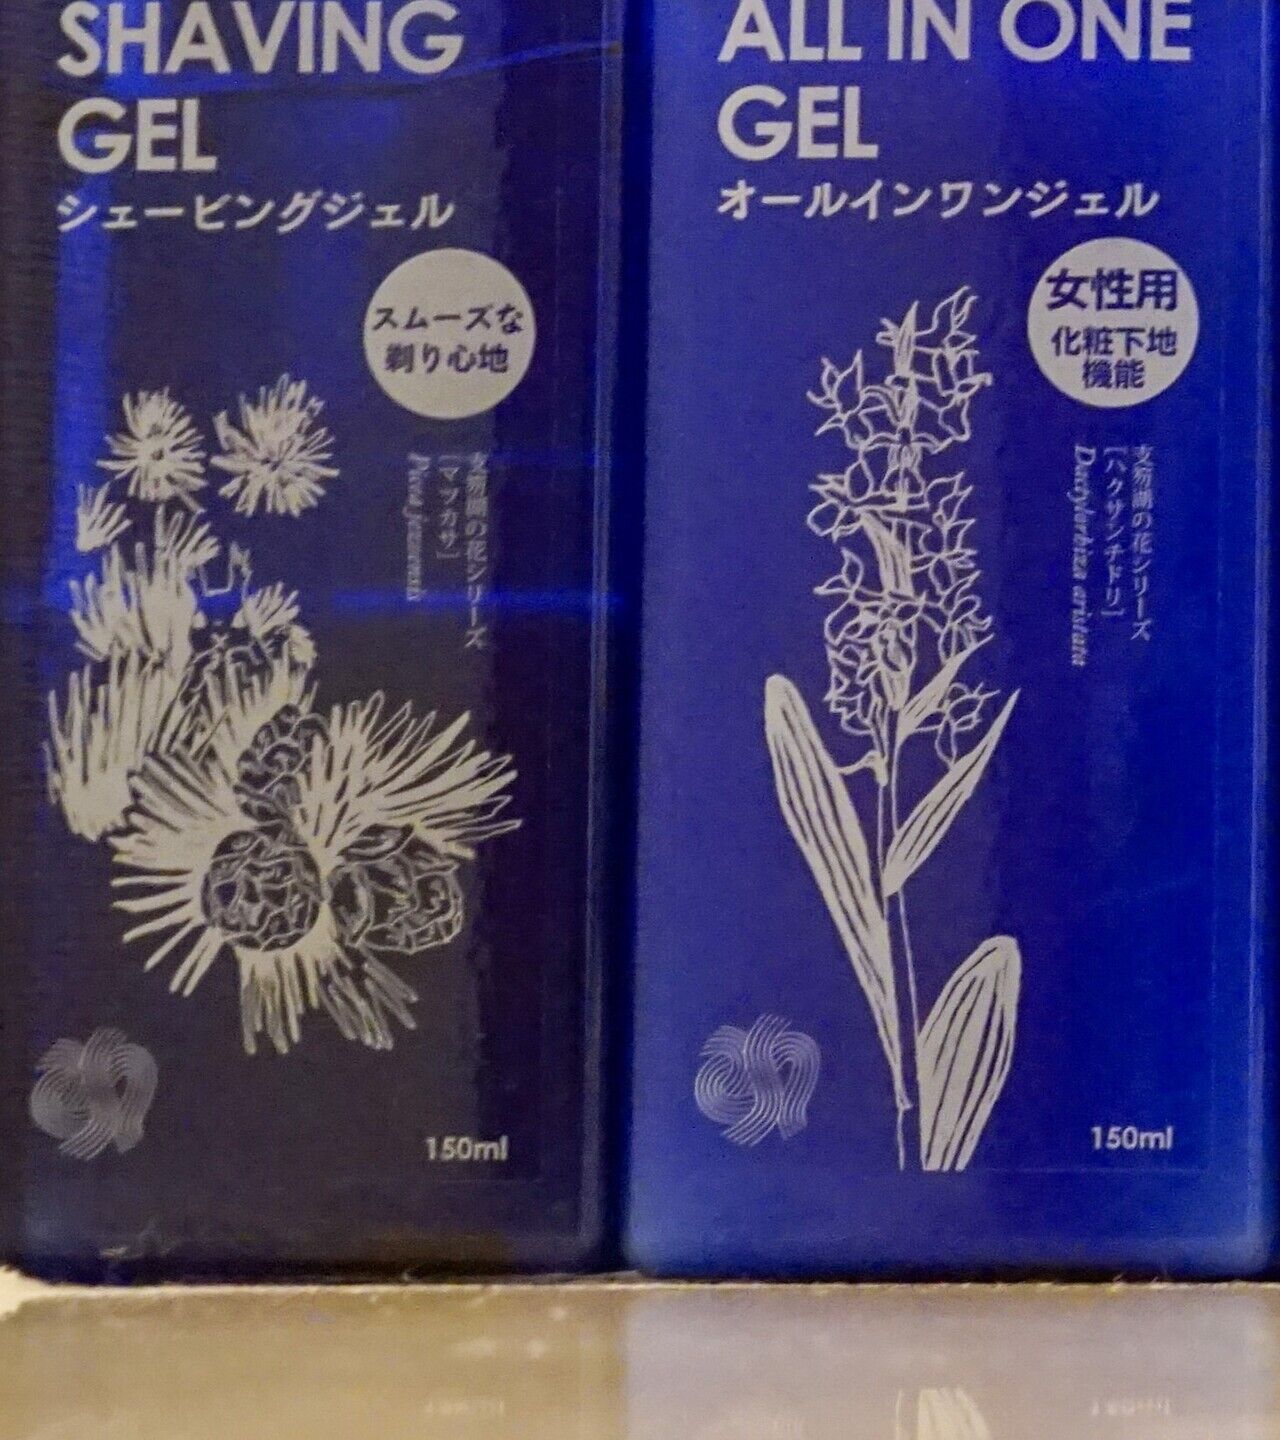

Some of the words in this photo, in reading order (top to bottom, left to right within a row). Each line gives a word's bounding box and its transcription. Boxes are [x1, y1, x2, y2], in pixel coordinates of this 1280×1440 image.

[57, 97, 218, 175] GEL
[717, 84, 879, 161] GEL
[56, 189, 455, 234] シェービングジェル
[716, 178, 1160, 221] オールインワンジェル
[1046, 268, 1177, 311] 女性用
[372, 302, 524, 336] スムーズな
[385, 343, 510, 374] 剃り心地
[1051, 326, 1178, 357] 化粧下地
[1082, 359, 1145, 389] 機能
[426, 1135, 508, 1161] 150ml
[1091, 1125, 1174, 1150] 150ml
